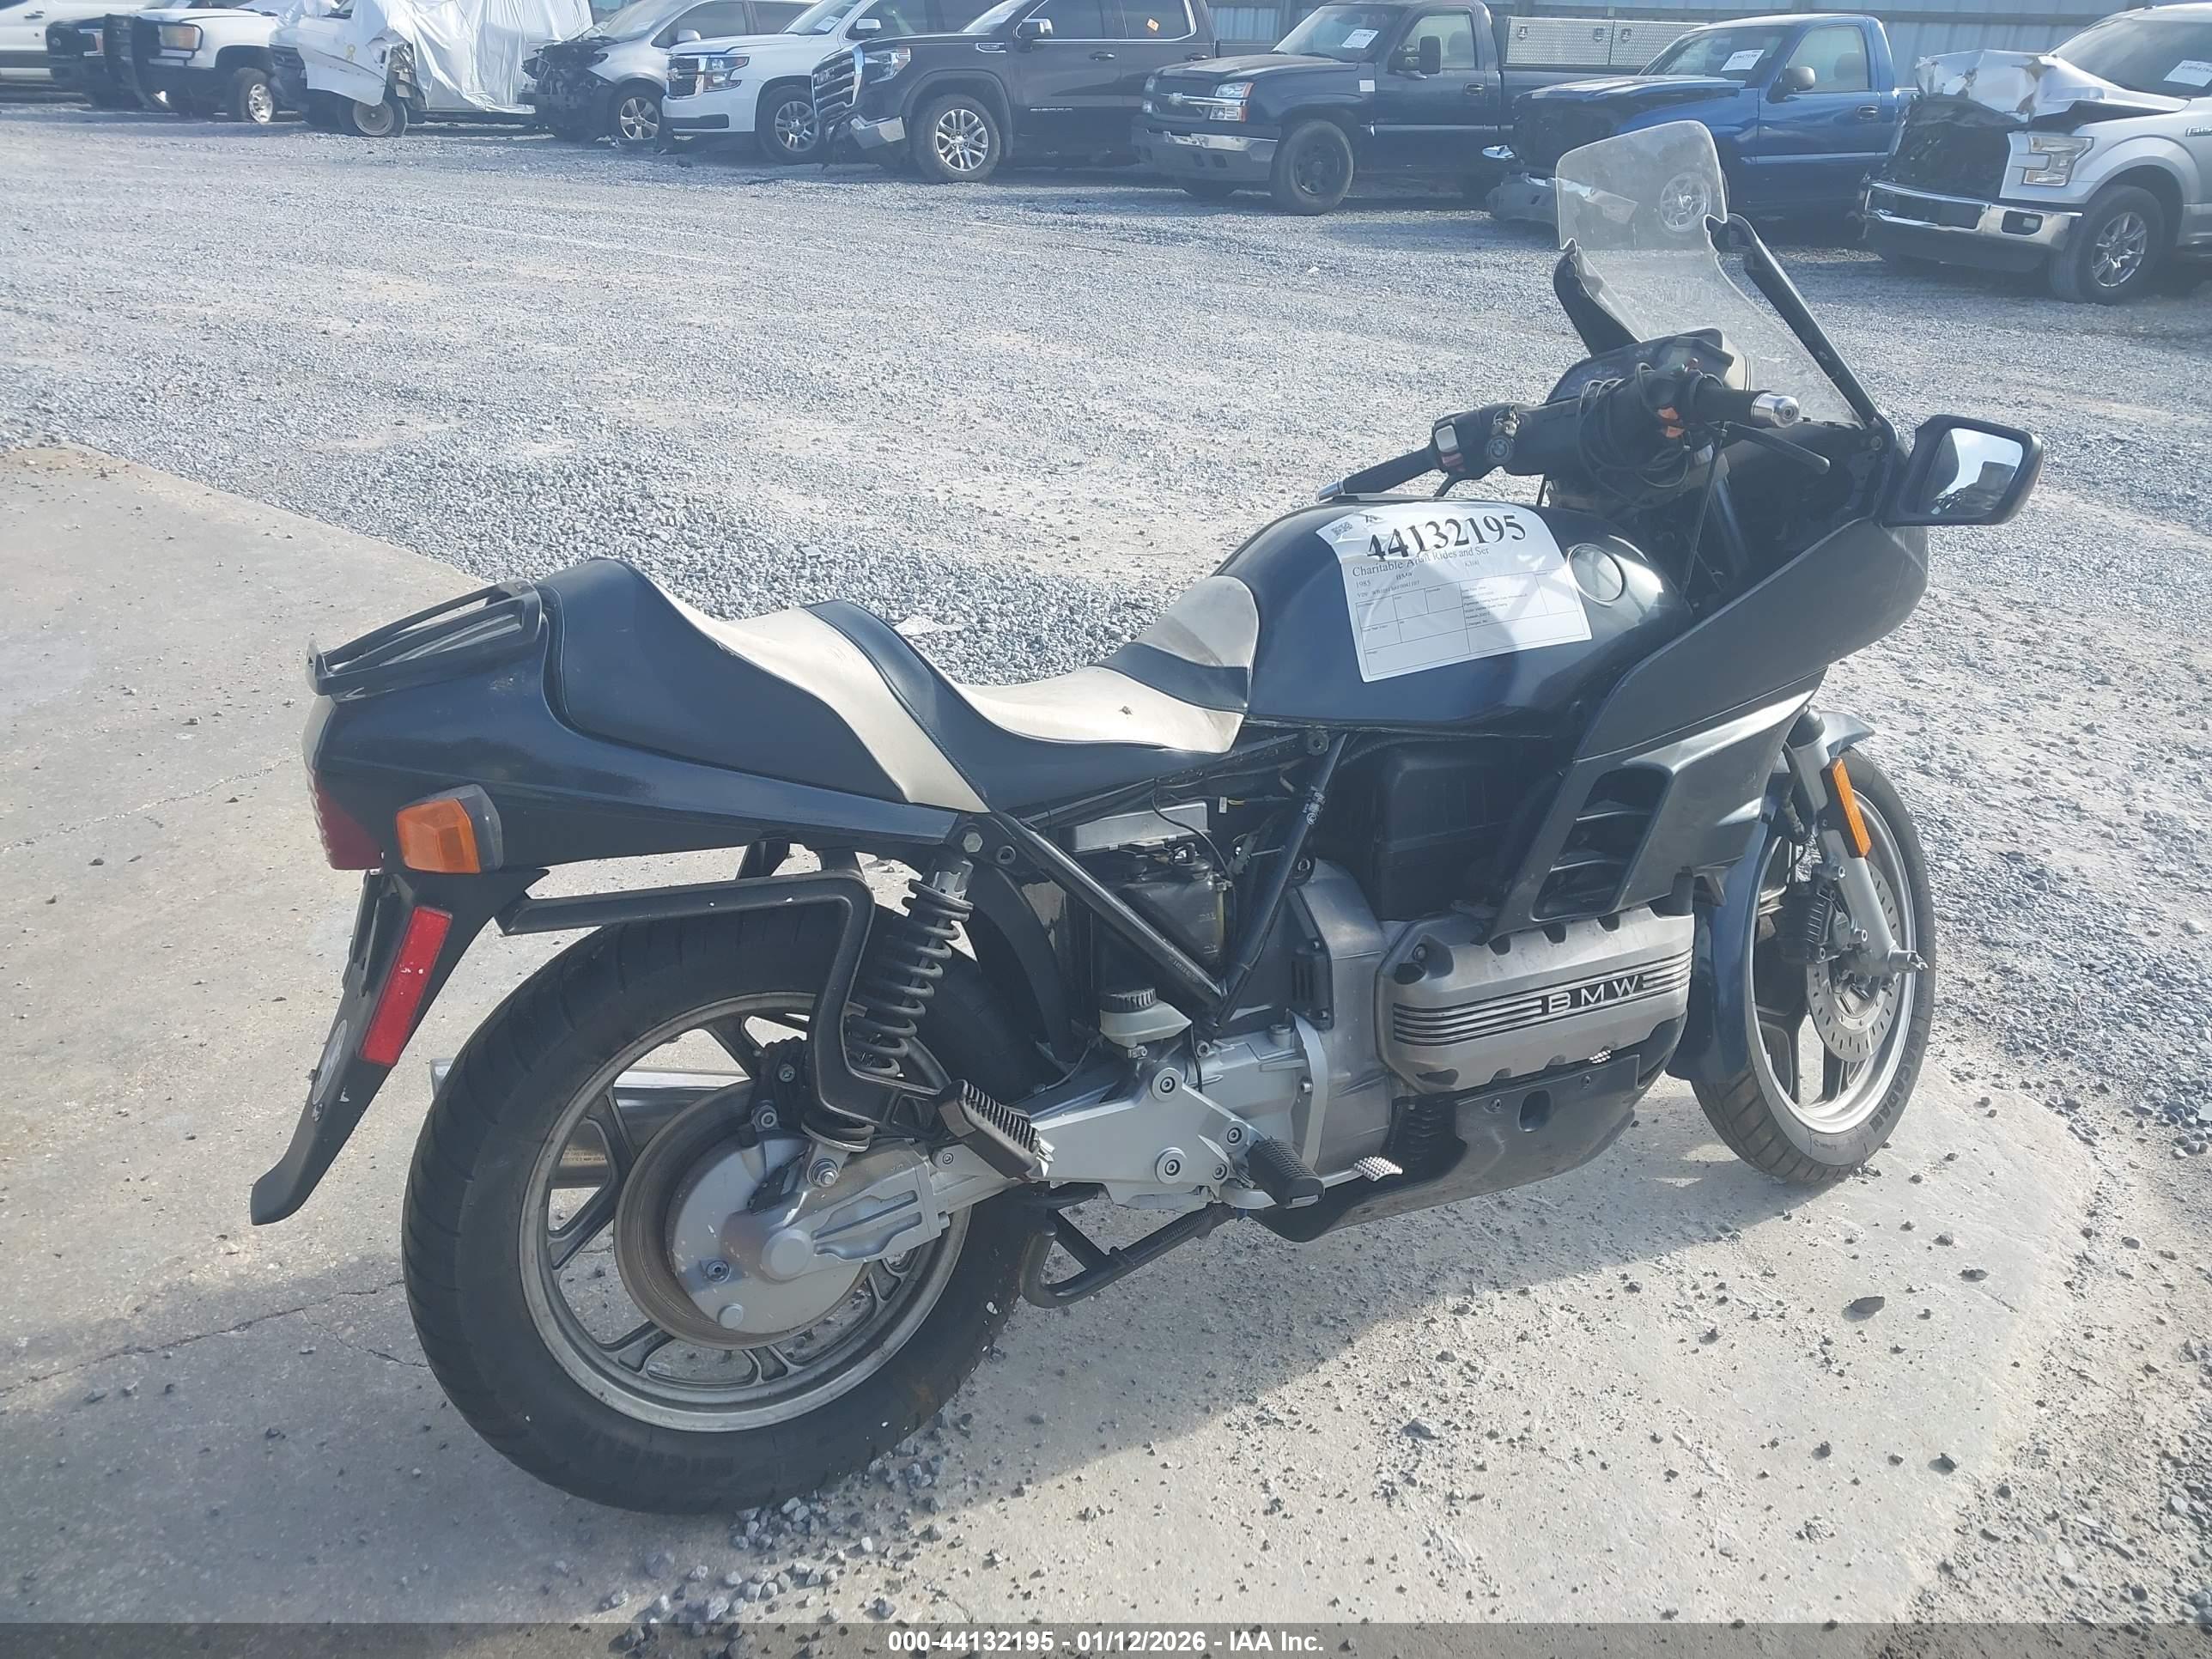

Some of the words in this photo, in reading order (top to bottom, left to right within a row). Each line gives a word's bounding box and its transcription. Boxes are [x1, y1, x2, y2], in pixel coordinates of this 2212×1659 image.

[1367, 514, 1526, 562] 44132195
[1352, 561, 1403, 577] Charitable
[1433, 550, 1457, 561] Rides
[1459, 547, 1474, 557] and
[1476, 546, 1489, 556] Ser
[1548, 975, 1639, 1013] BMW
